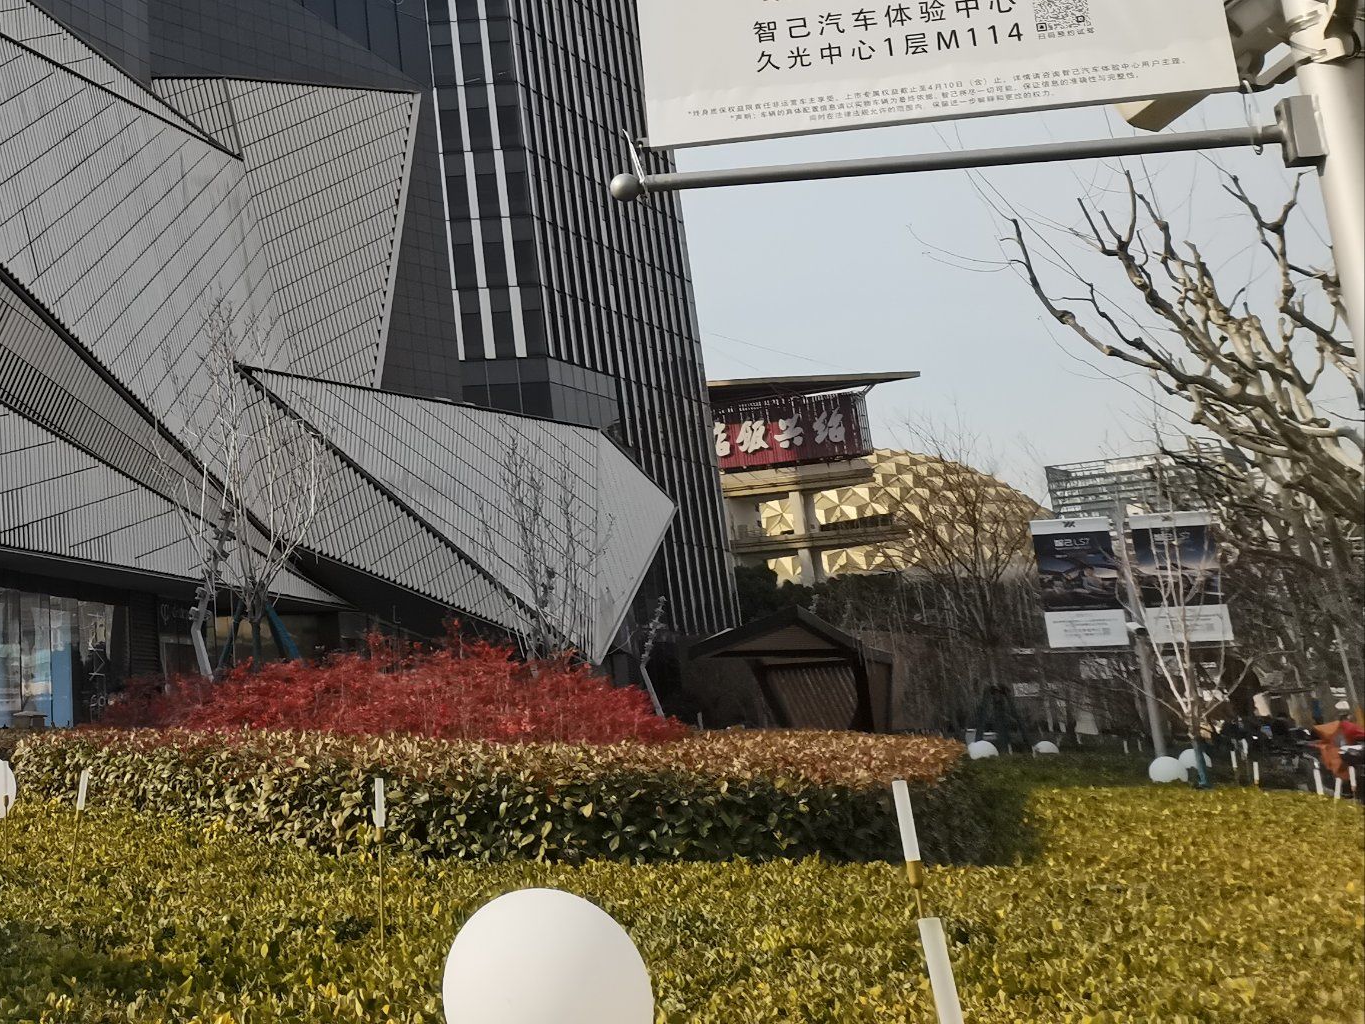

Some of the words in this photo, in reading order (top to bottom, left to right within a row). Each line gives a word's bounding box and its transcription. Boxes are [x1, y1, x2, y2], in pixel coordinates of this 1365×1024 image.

[755, 22, 1025, 73] 久光中心1层M114
